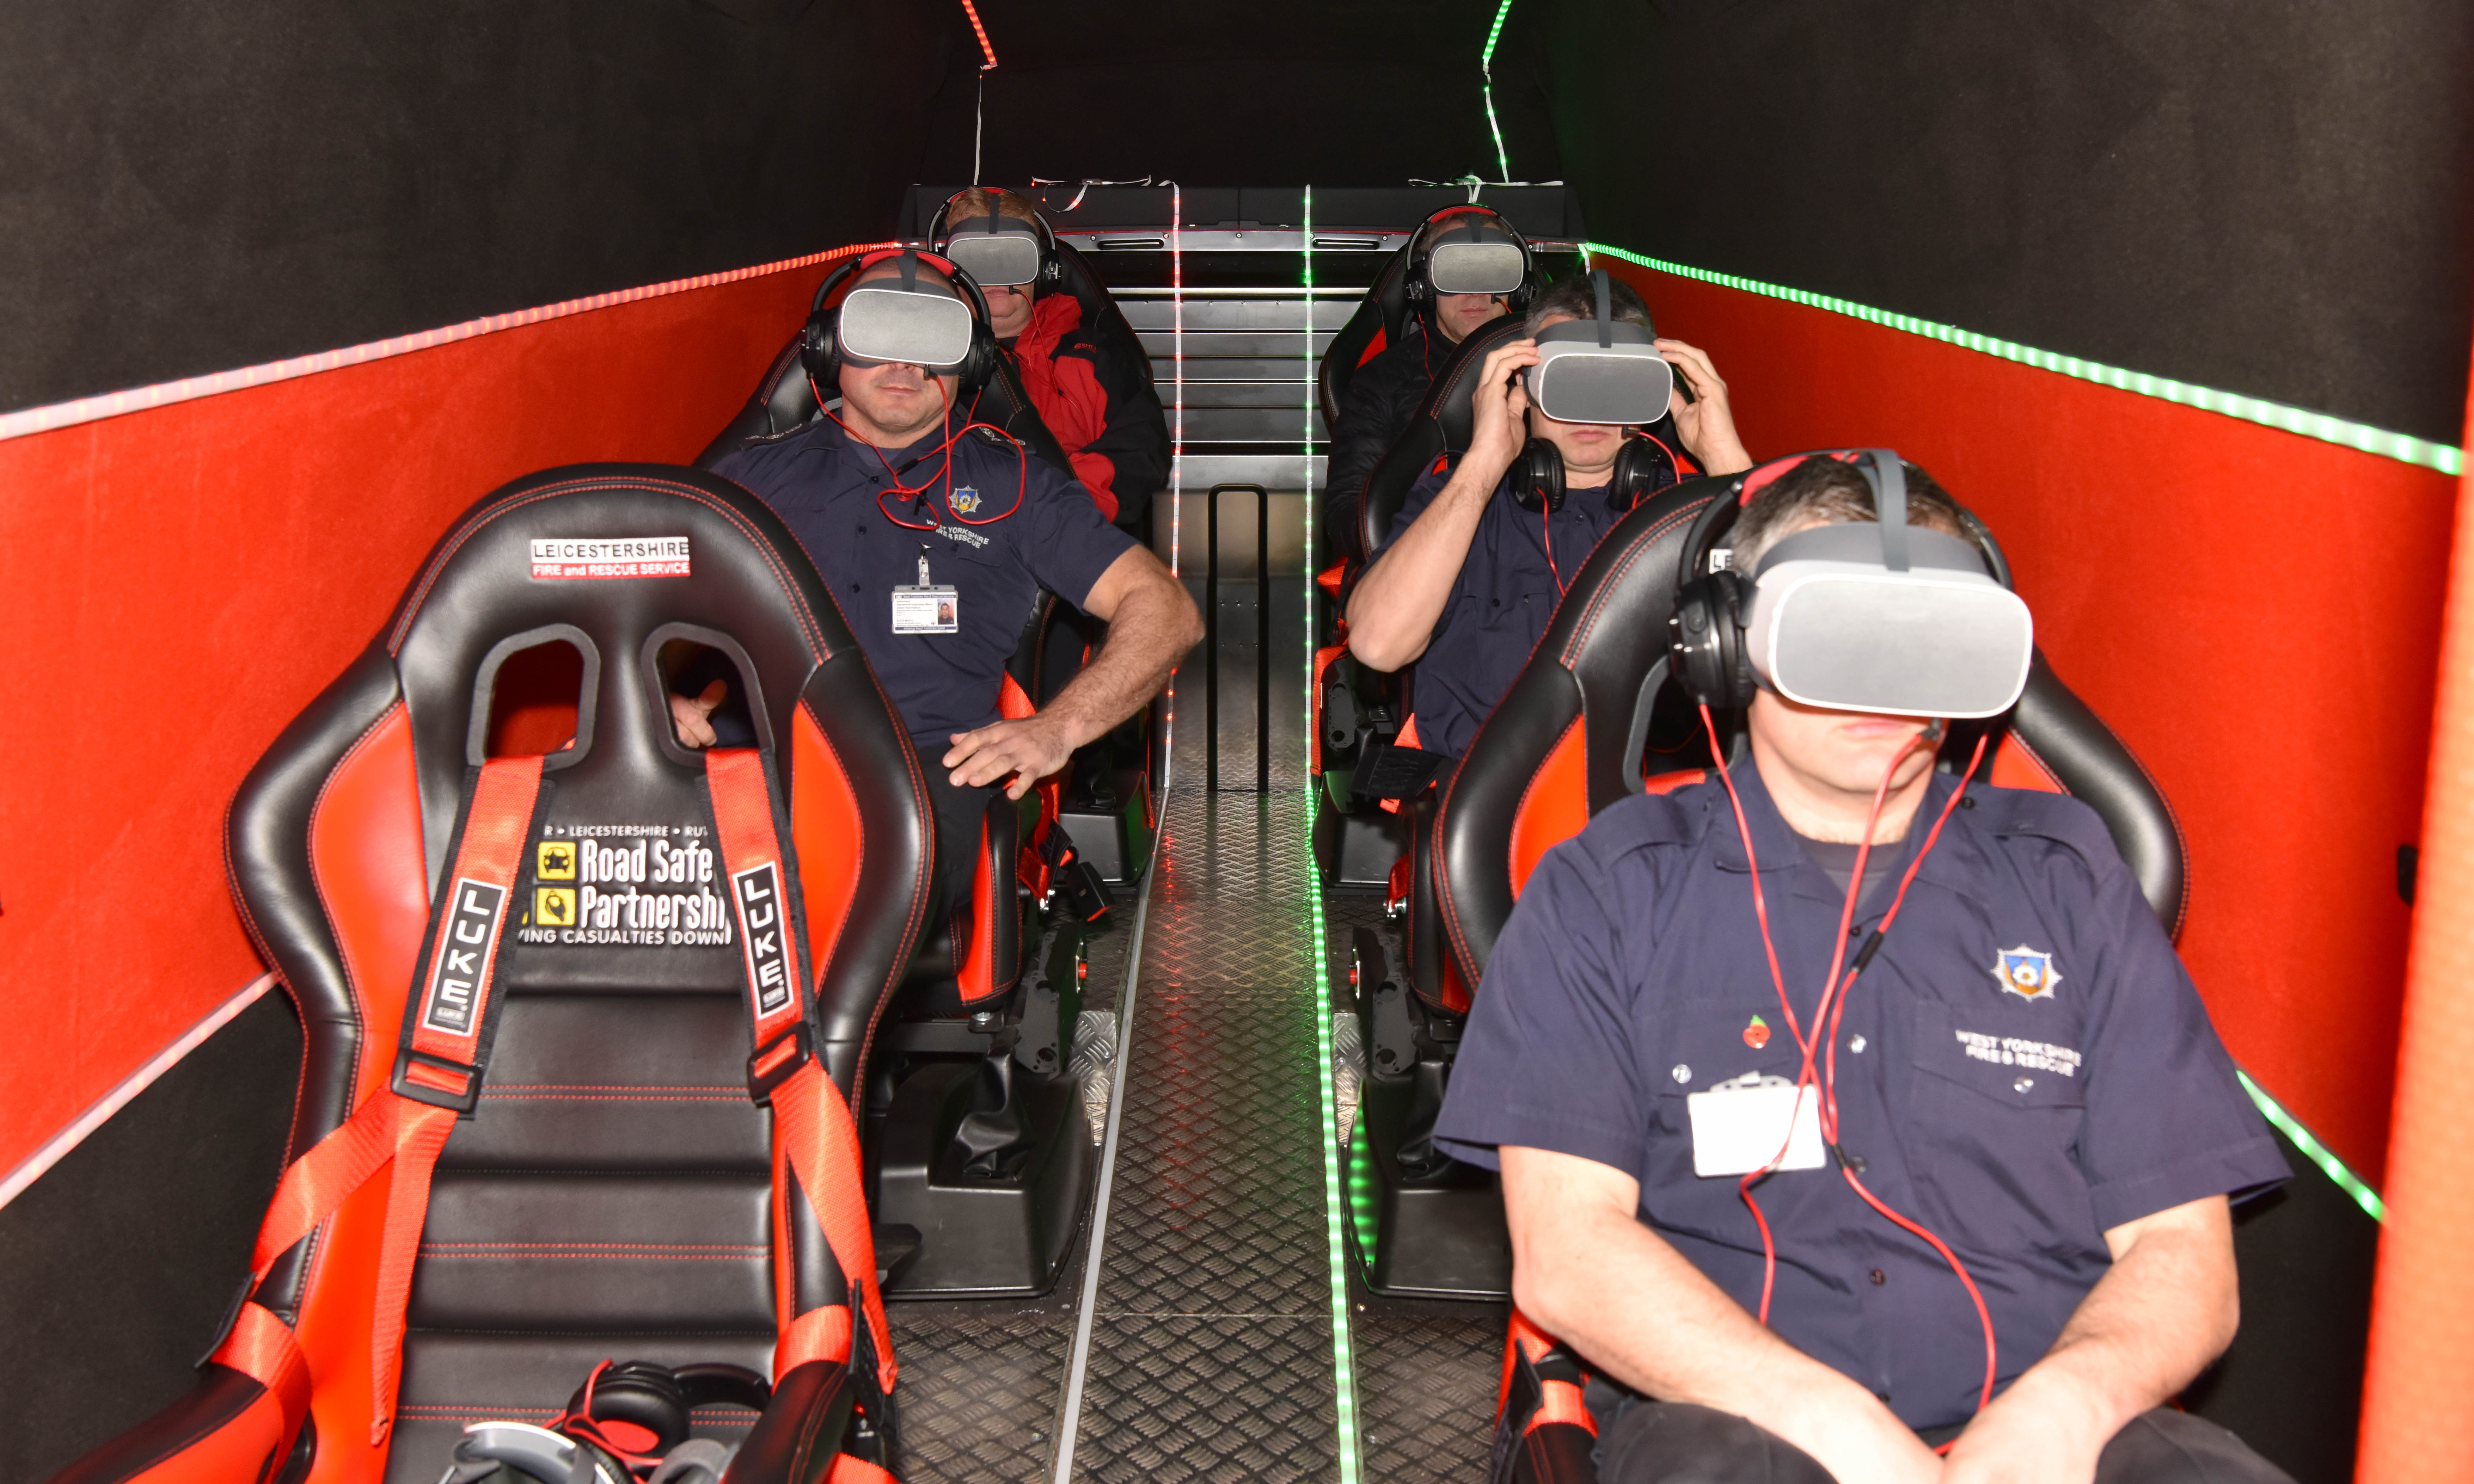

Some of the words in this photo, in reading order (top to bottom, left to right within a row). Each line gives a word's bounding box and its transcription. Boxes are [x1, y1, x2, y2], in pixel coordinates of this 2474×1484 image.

[936, 529, 948, 537] IRE
[954, 534, 981, 549] RESCUE
[948, 527, 989, 544] YORKSHIRE
[534, 542, 689, 558] LEICESTERSHIRE
[533, 564, 562, 576] FIRE
[564, 565, 587, 576] and
[588, 564, 638, 575] RESCUE
[640, 562, 689, 575] SERVICE
[570, 825, 668, 837] LEICESTERSHIRE
[582, 839, 647, 882] Road
[656, 839, 712, 882] Safe
[563, 930, 665, 944] CASUALTIES
